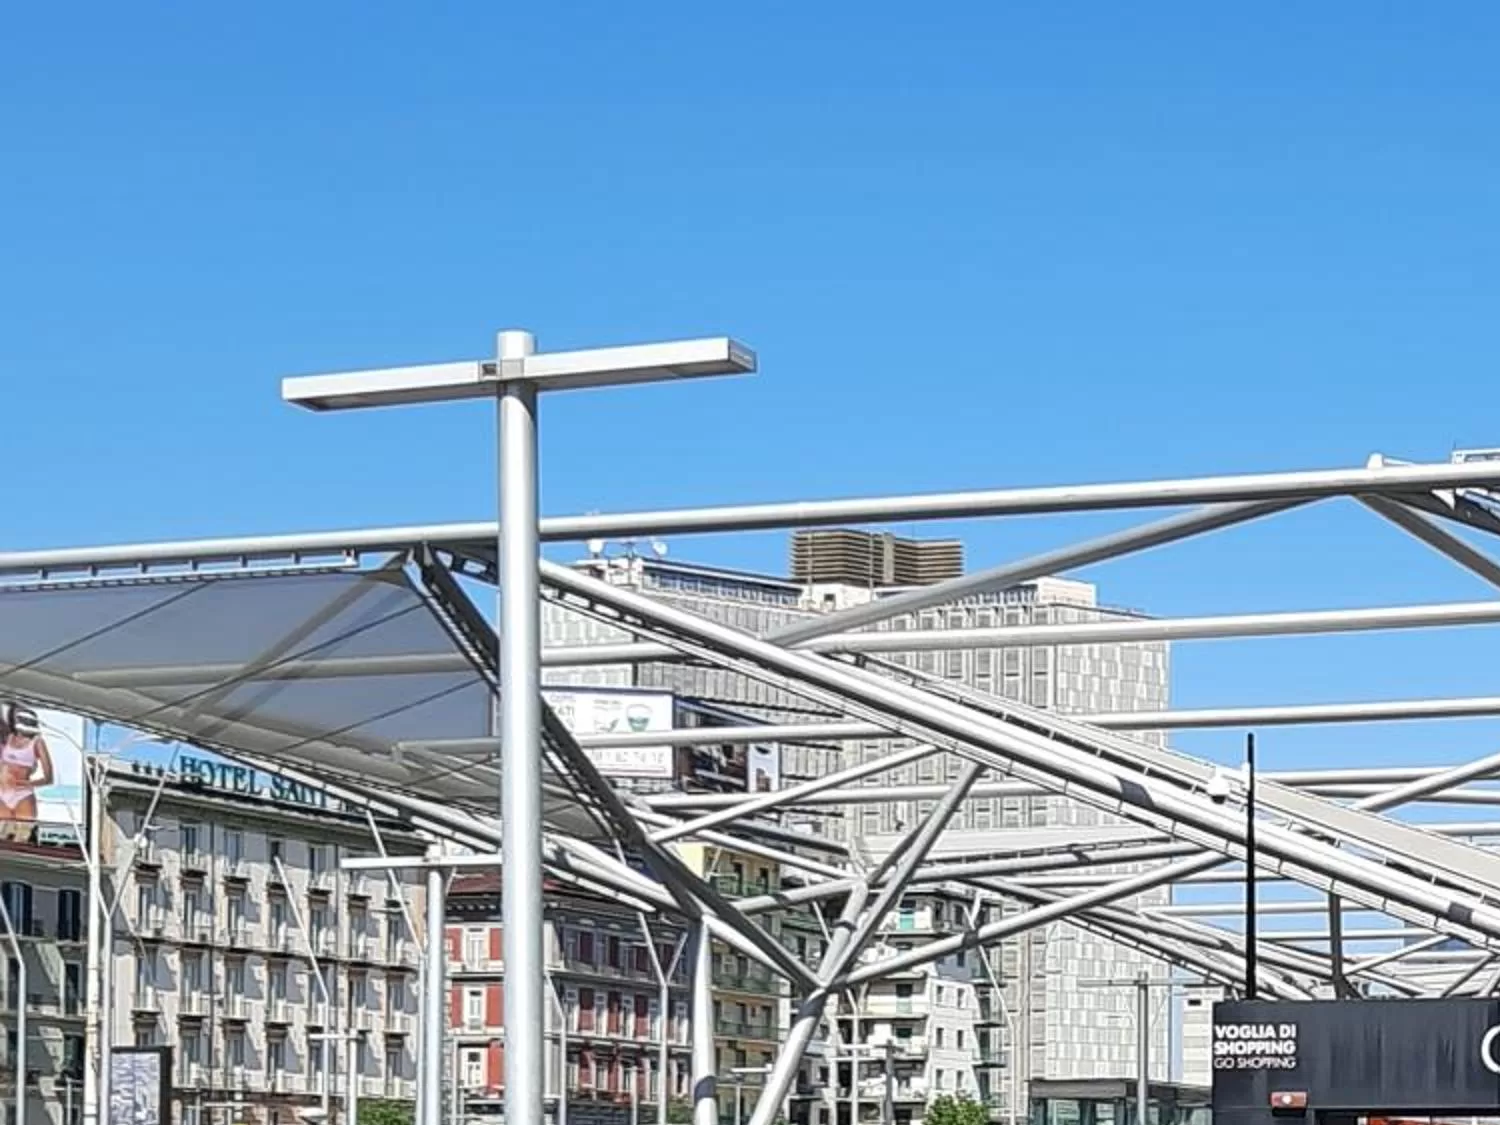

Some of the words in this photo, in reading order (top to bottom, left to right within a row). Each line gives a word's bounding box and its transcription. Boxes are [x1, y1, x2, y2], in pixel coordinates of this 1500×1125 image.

[180, 755, 263, 796] HOTEL
[1214, 1024, 1277, 1039] VOGLIA
[1279, 1023, 1297, 1039] DI
[1214, 1040, 1297, 1055] SHOPPING
[1214, 1057, 1235, 1069] GO
[1237, 1056, 1297, 1069] SHOPPING
